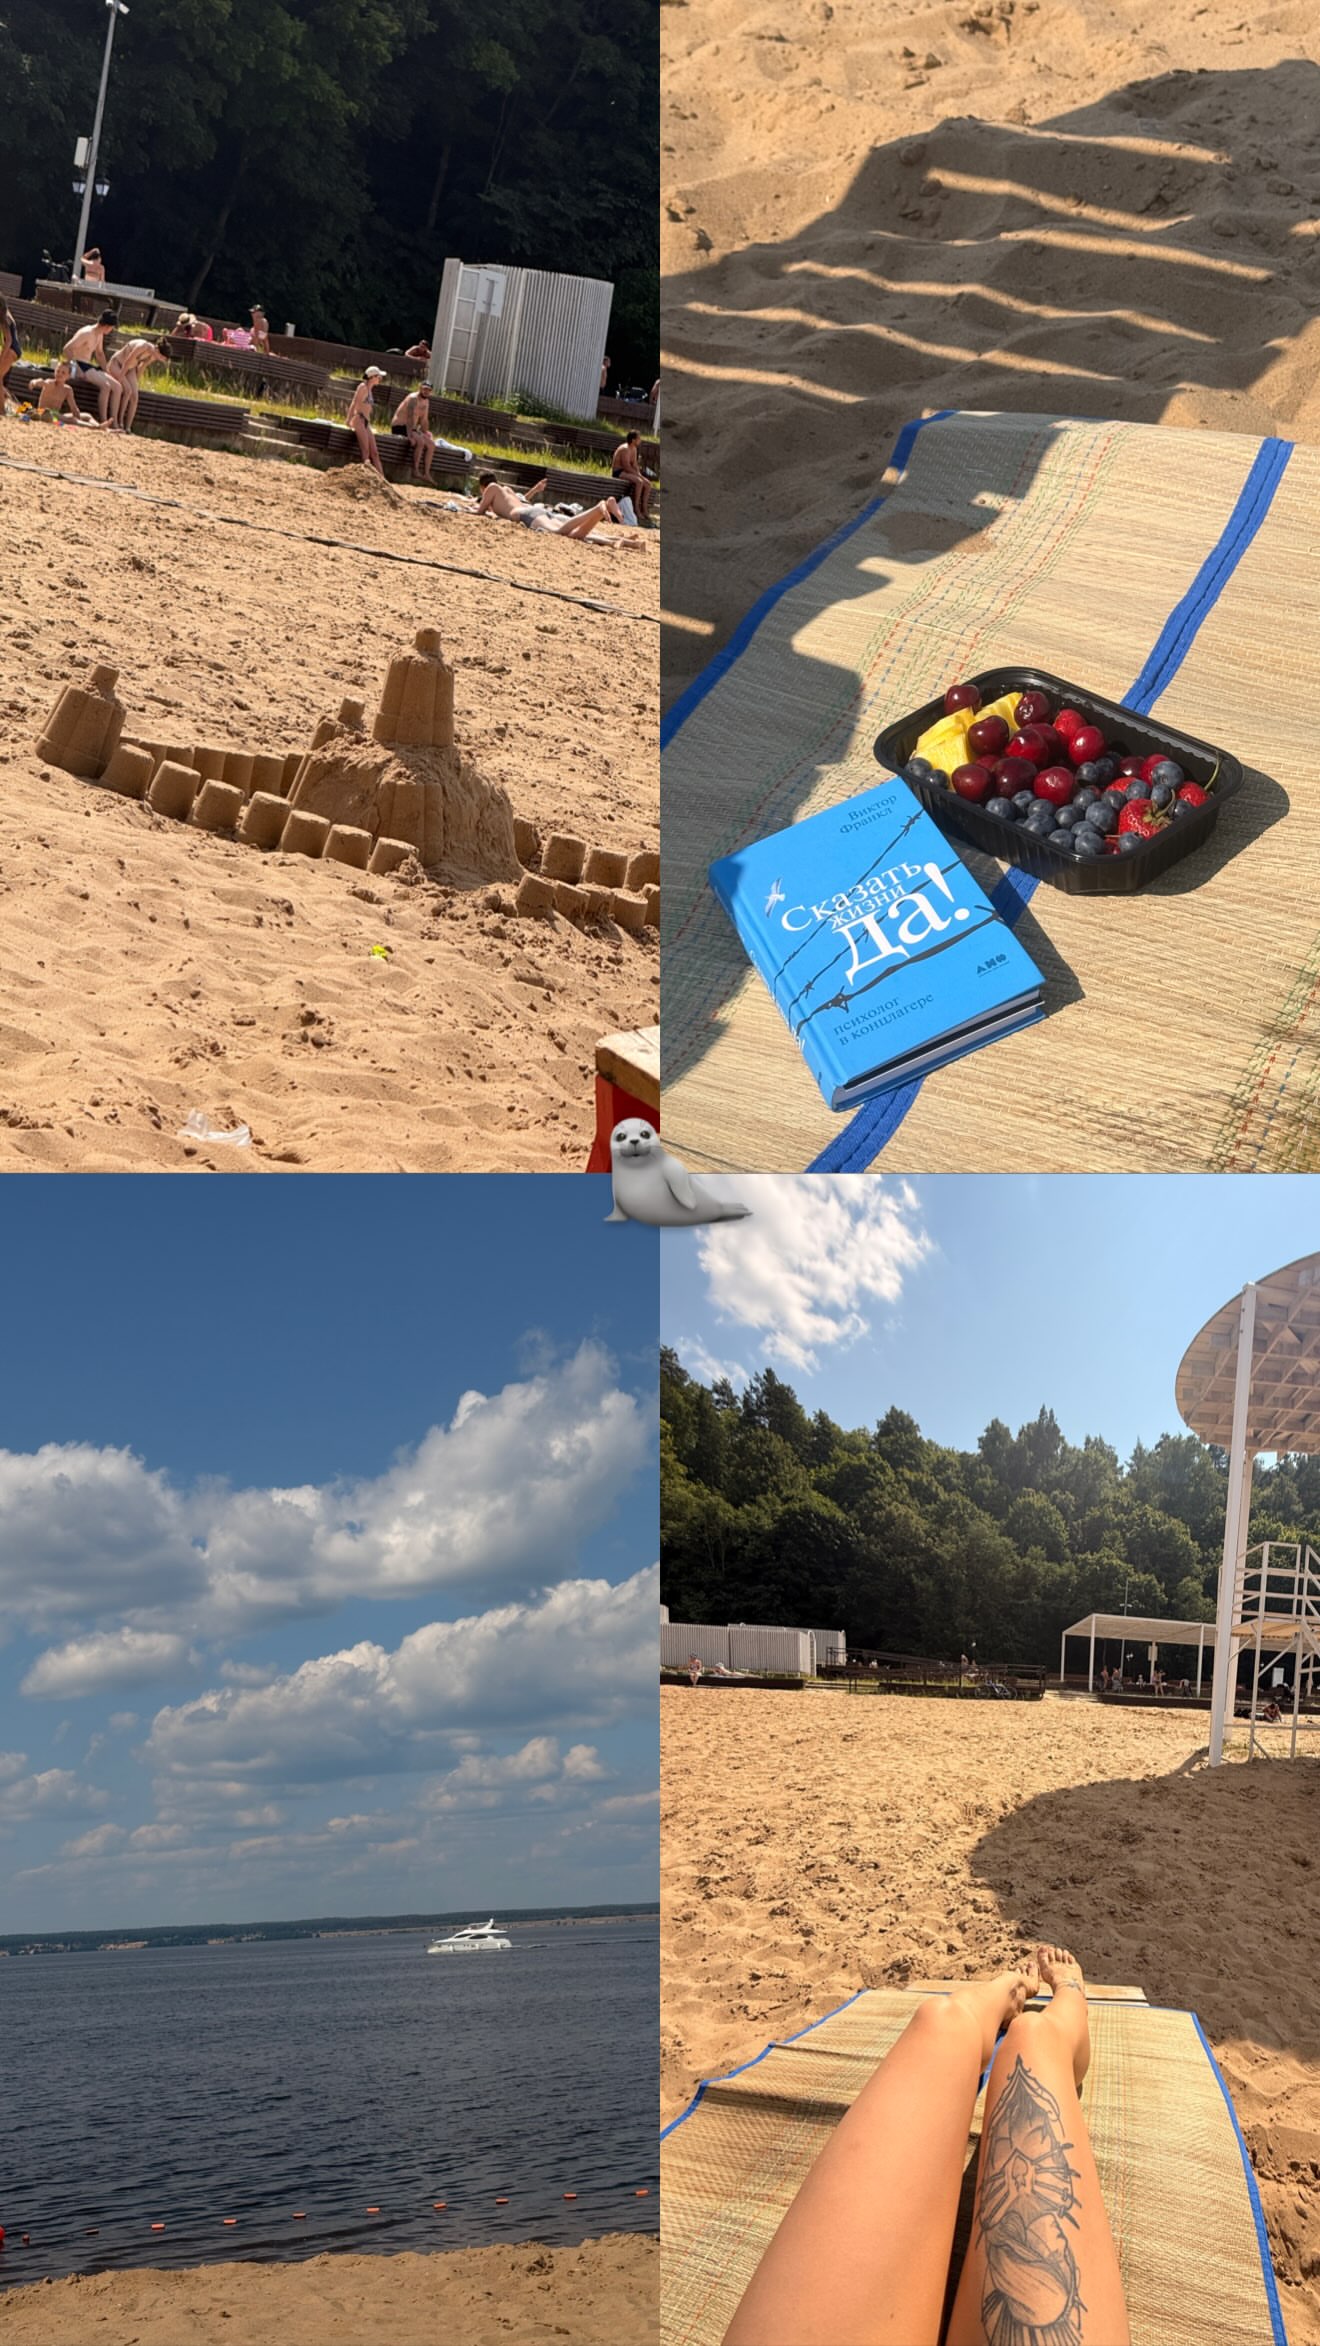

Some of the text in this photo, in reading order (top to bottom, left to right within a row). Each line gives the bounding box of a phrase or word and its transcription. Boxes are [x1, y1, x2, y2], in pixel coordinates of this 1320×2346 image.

[840, 807, 892, 833] Франкл
[848, 795, 897, 821] Виктор
[781, 862, 922, 932] Сказать
[828, 885, 907, 930] жизни
[832, 862, 970, 987] Да!
[833, 997, 900, 1036] психолог
[839, 994, 934, 1047] в концлагере
